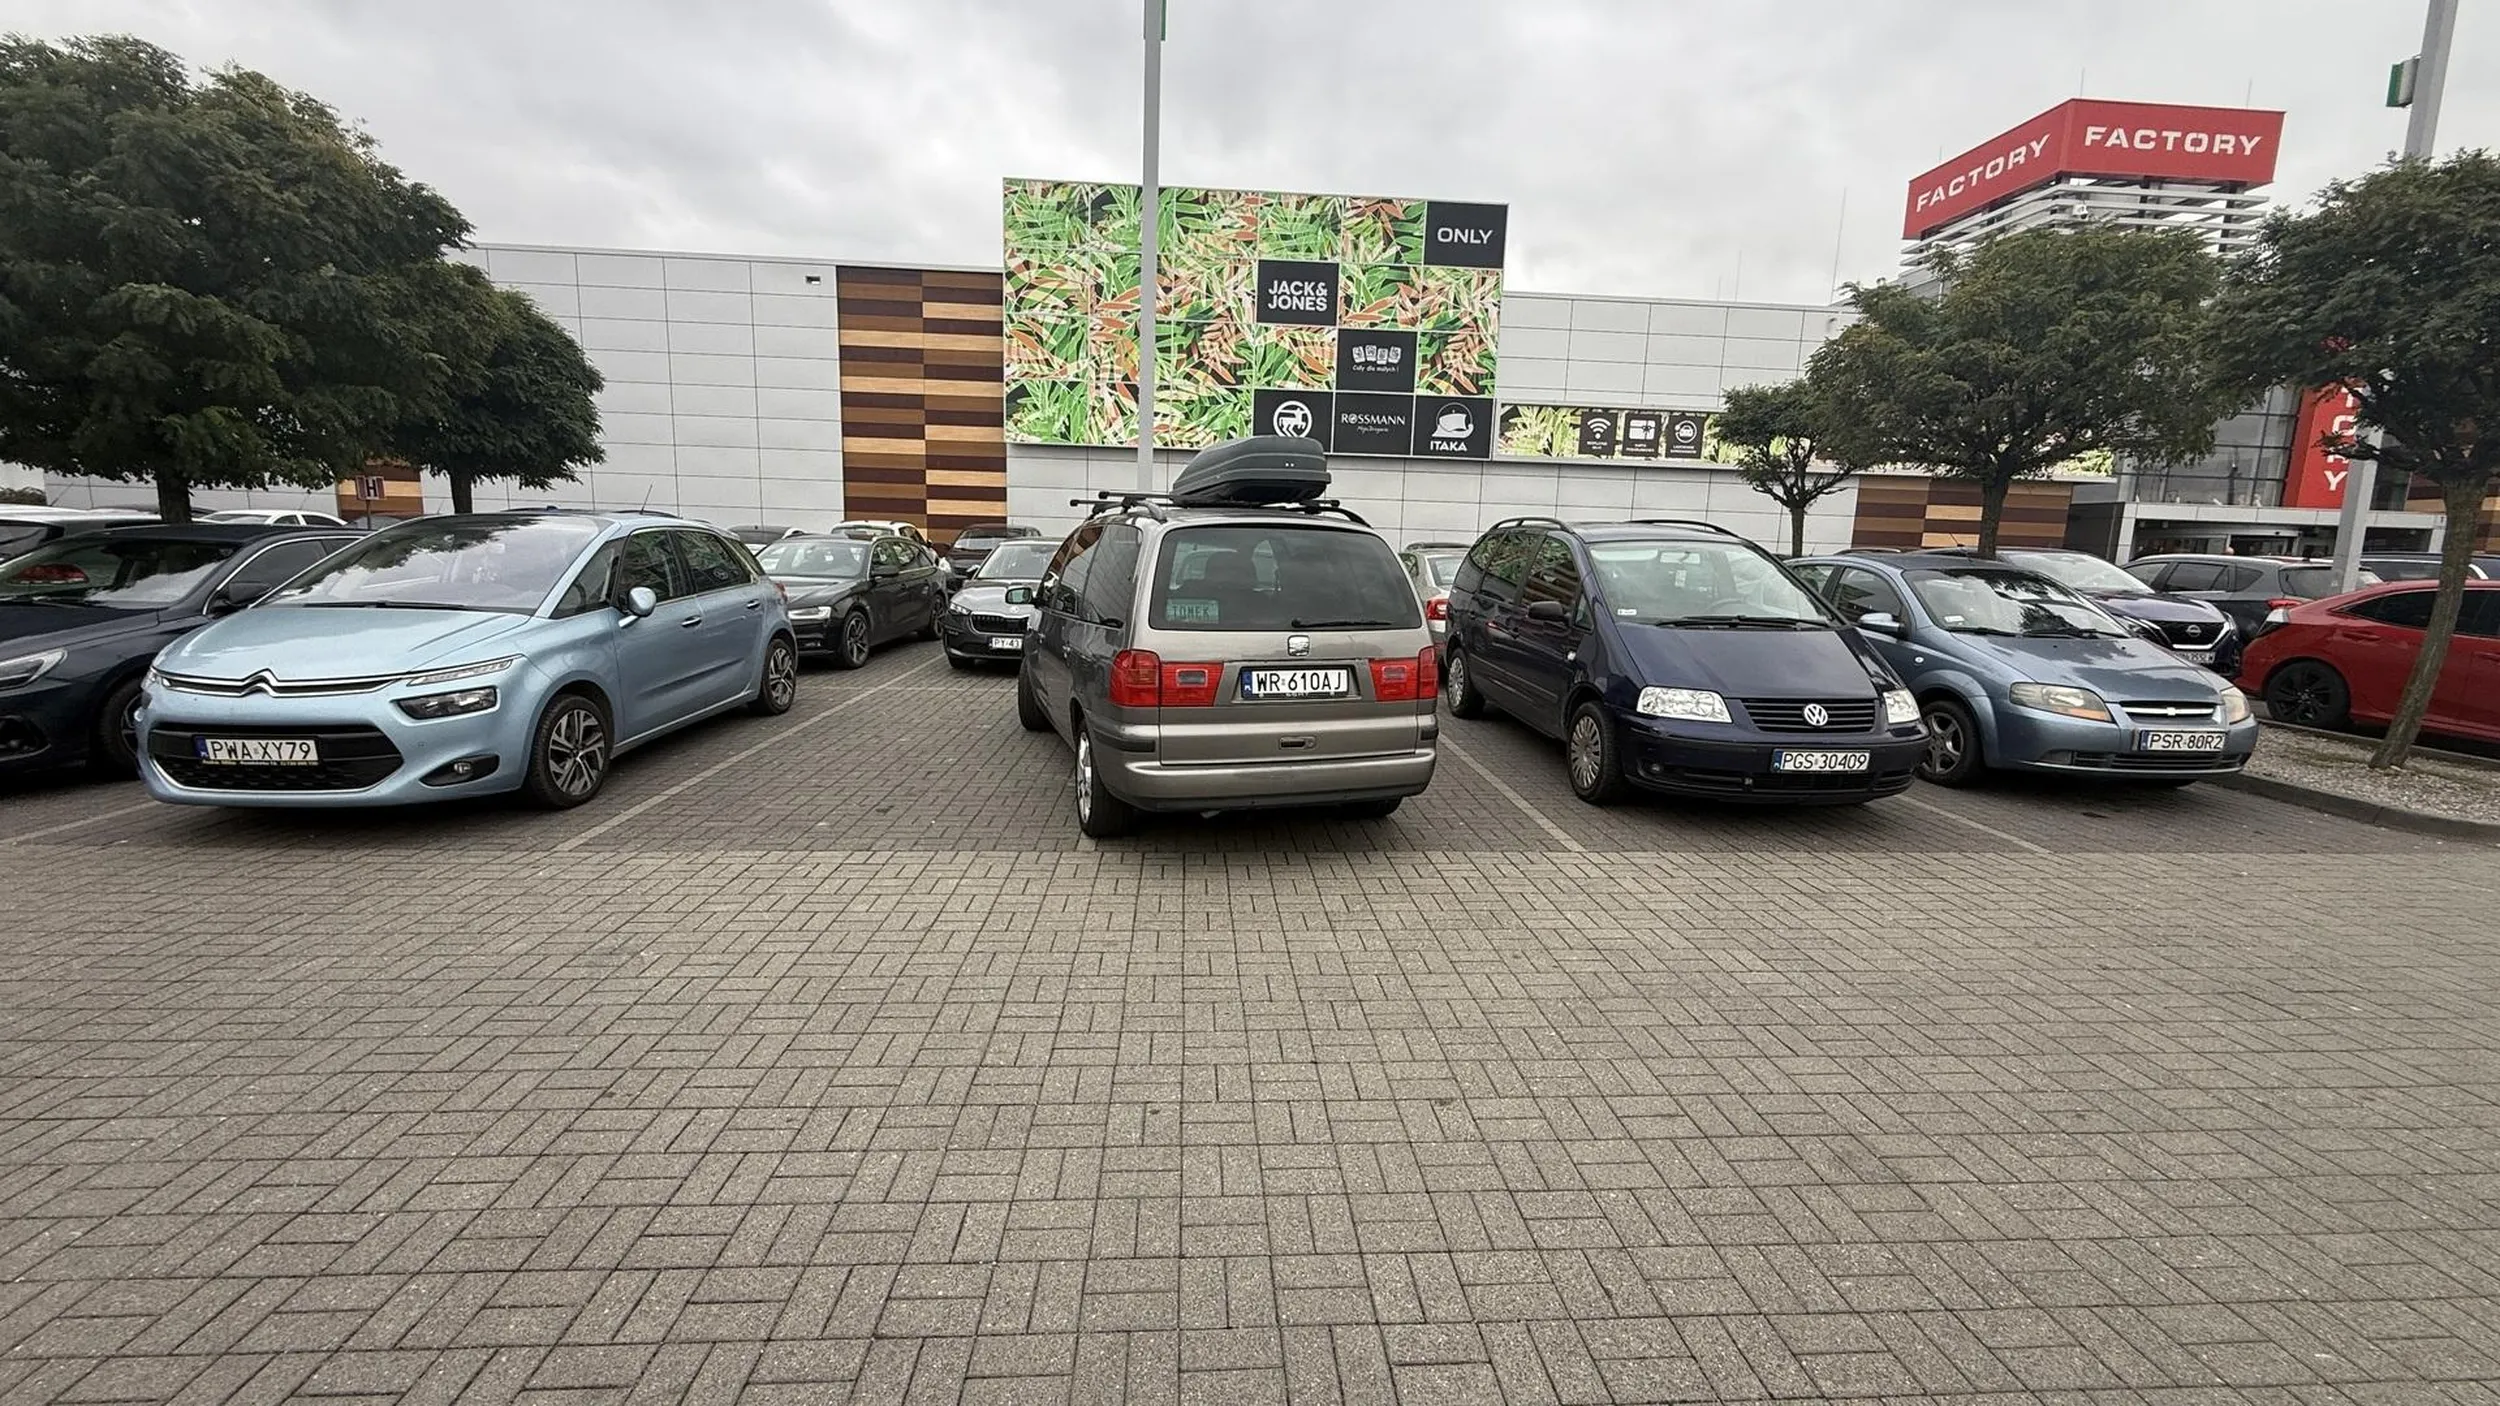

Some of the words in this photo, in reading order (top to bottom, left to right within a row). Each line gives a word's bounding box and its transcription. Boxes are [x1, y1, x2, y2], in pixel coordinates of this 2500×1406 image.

[2085, 126, 2262, 156] FACTORY
[1915, 134, 2051, 213] FACTORY
[1437, 227, 1494, 244] ONLY
[1268, 280, 1328, 296] JACK&
[1268, 295, 1328, 312] JONES
[1341, 413, 1406, 425] ROSSMANN
[1430, 441, 1468, 451] ITAKA
[366, 478, 378, 497] H
[1171, 604, 1211, 618] TOMEK
[1257, 673, 1281, 691] WR
[1288, 672, 1341, 691] 610AJ
[210, 741, 253, 759] PWA
[258, 741, 311, 759] XY79
[2149, 734, 2184, 749] PSR
[2187, 735, 2223, 749] 80R2
[1783, 753, 1815, 769] PGS
[1819, 753, 1867, 769] 30409
